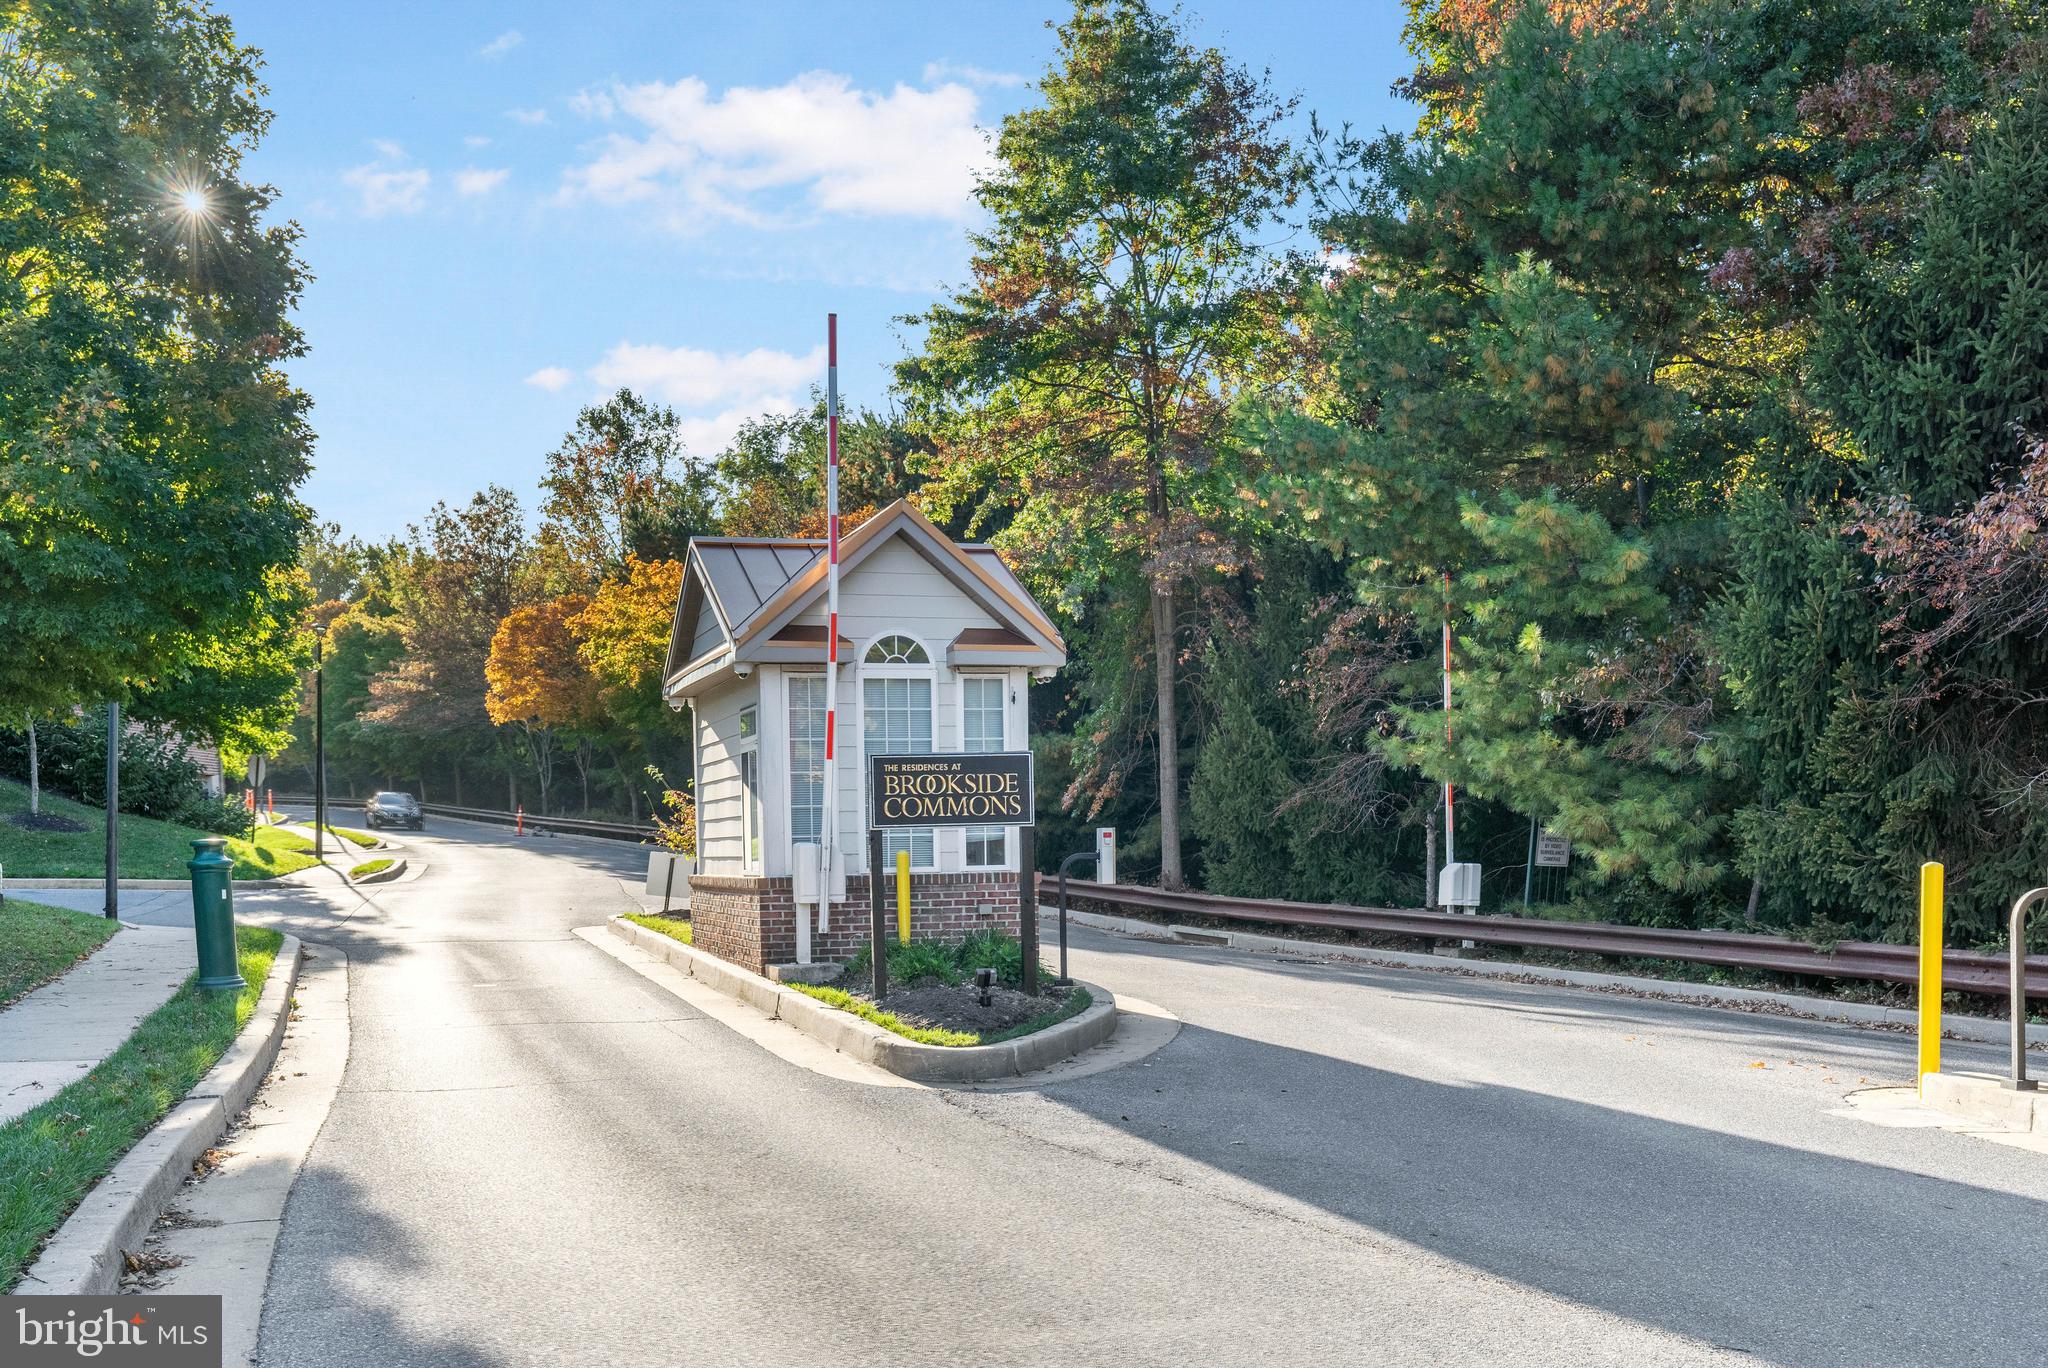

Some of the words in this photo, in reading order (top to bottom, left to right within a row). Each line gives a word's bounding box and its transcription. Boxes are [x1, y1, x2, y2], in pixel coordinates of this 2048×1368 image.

[884, 764, 898, 772] THE
[901, 763, 948, 772] RESIDENCES
[951, 763, 962, 771] AT
[884, 773, 1019, 796] BROOKSIDE
[883, 795, 1022, 818] COMMONS
